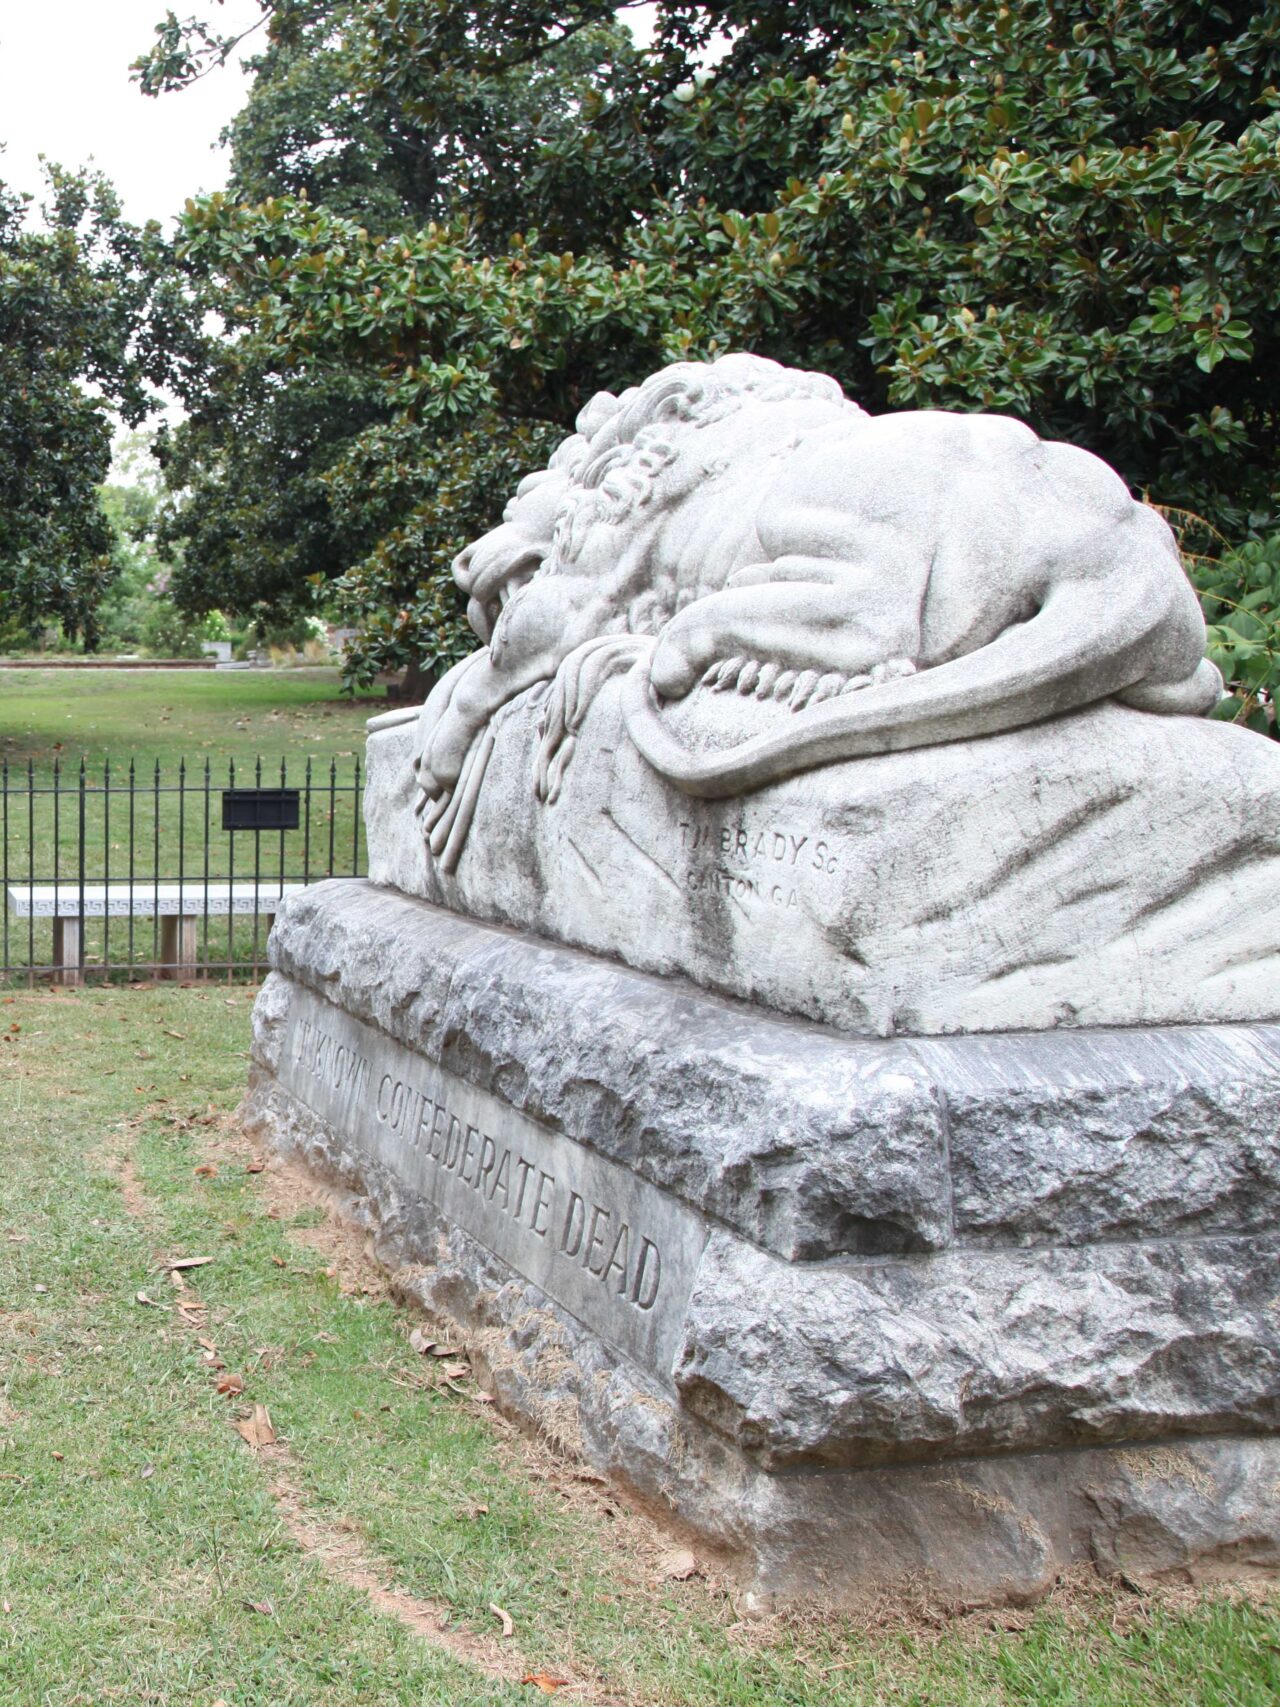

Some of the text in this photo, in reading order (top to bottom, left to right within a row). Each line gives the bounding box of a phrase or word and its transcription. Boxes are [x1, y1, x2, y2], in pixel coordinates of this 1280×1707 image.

[720, 826, 809, 866] BRADY
[770, 883, 799, 909] GA
[376, 1073, 556, 1237] CONFEDERATE
[558, 1190, 662, 1311] DEAD
